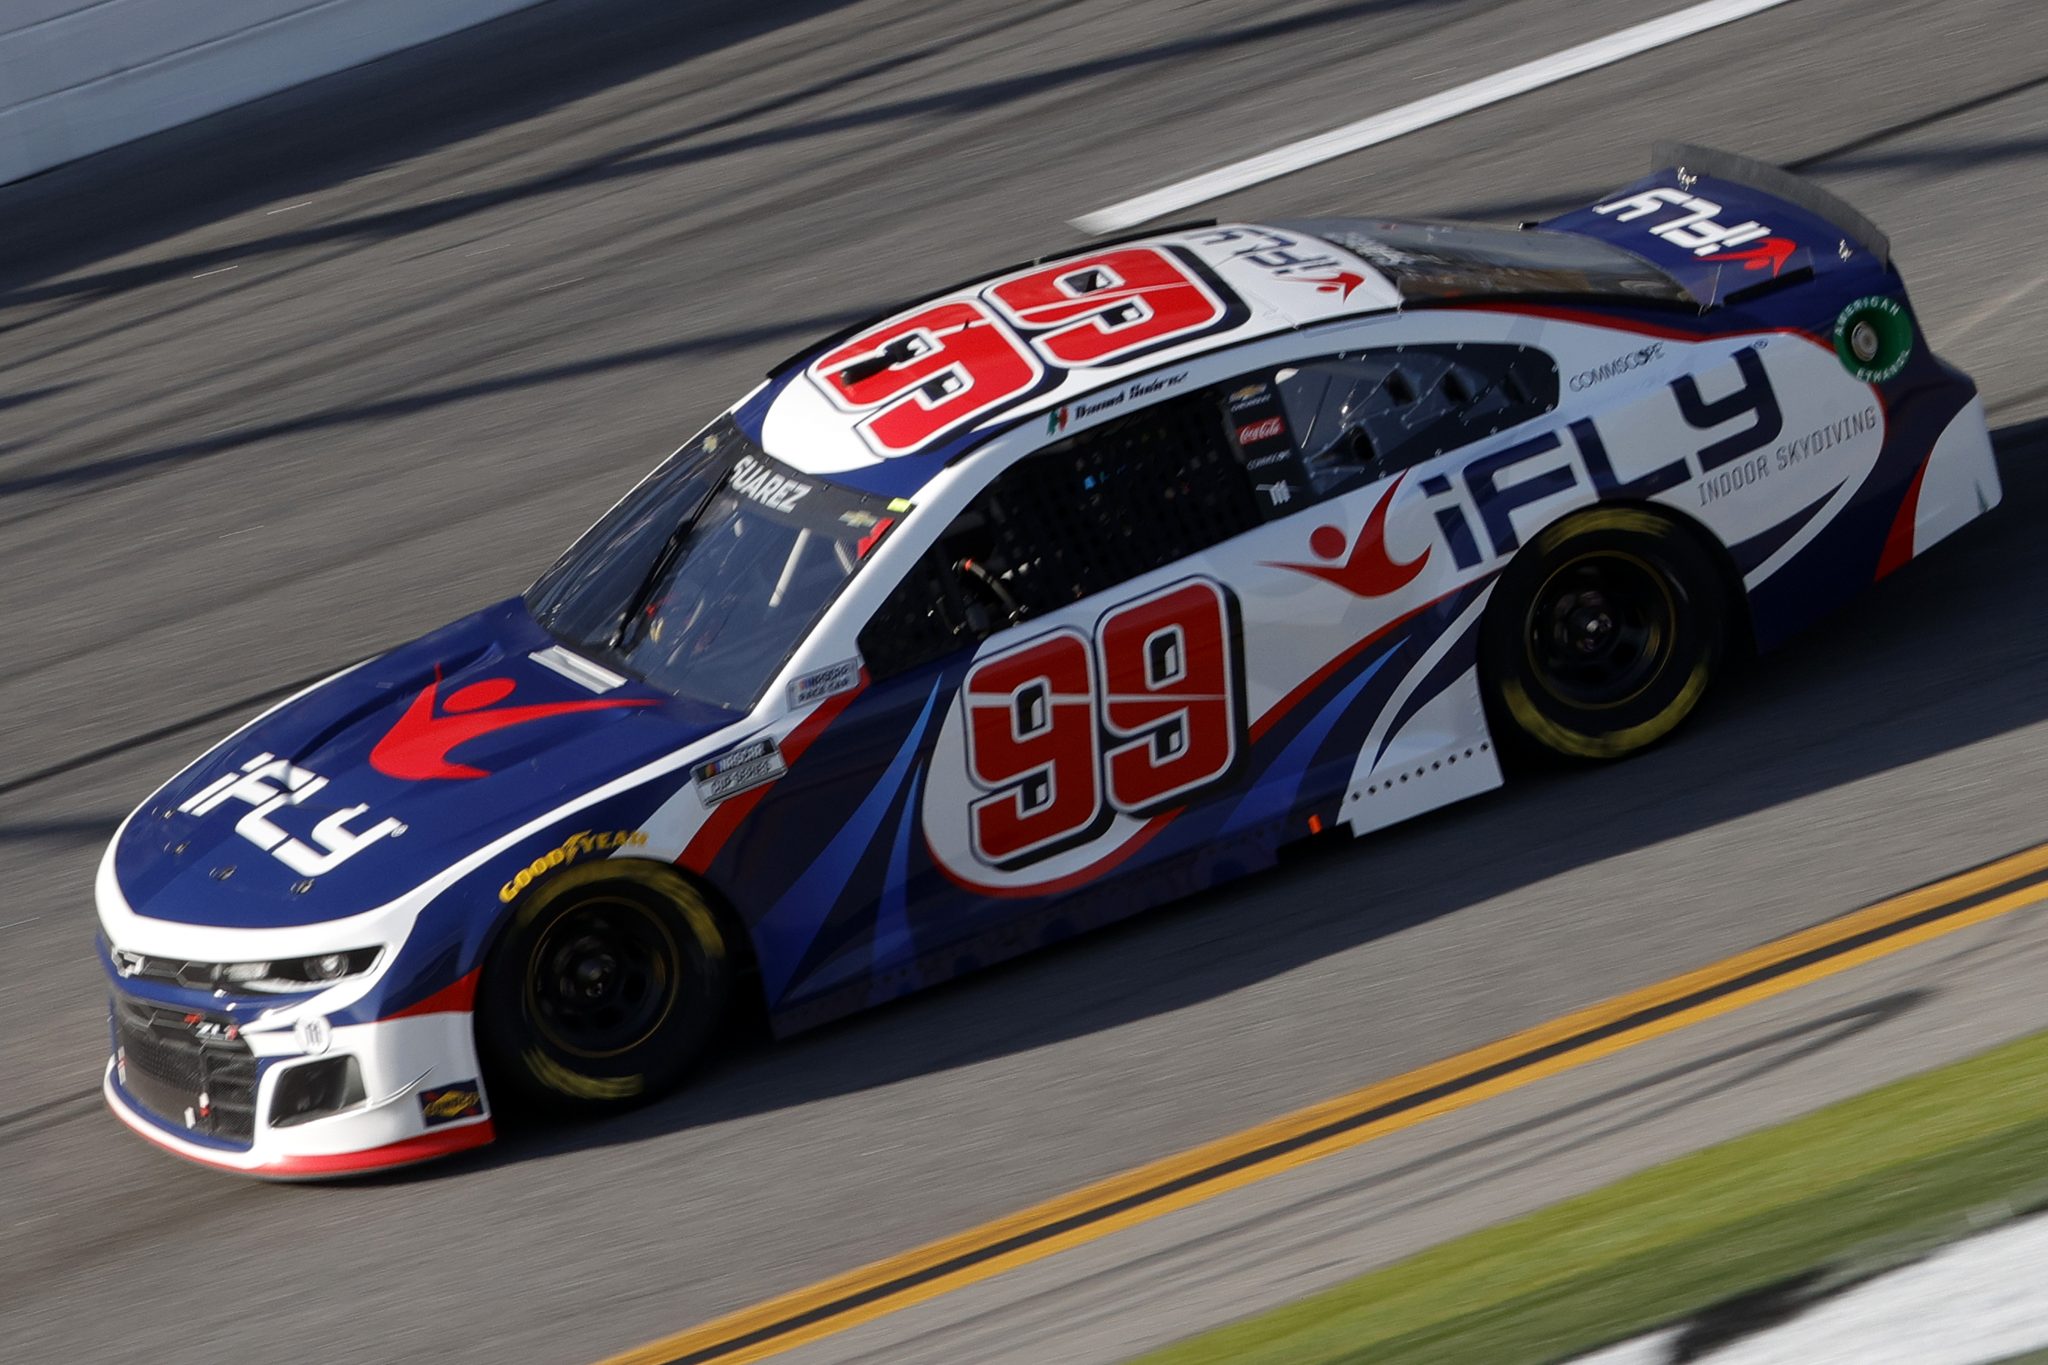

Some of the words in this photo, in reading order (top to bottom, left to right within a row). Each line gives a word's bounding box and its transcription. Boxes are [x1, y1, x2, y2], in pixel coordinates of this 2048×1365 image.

[728, 454, 813, 514] SUAREZ
[1699, 455, 1770, 507] INDOOR
[1776, 405, 1877, 471] SKYDIVING
[964, 575, 1244, 872] 99
